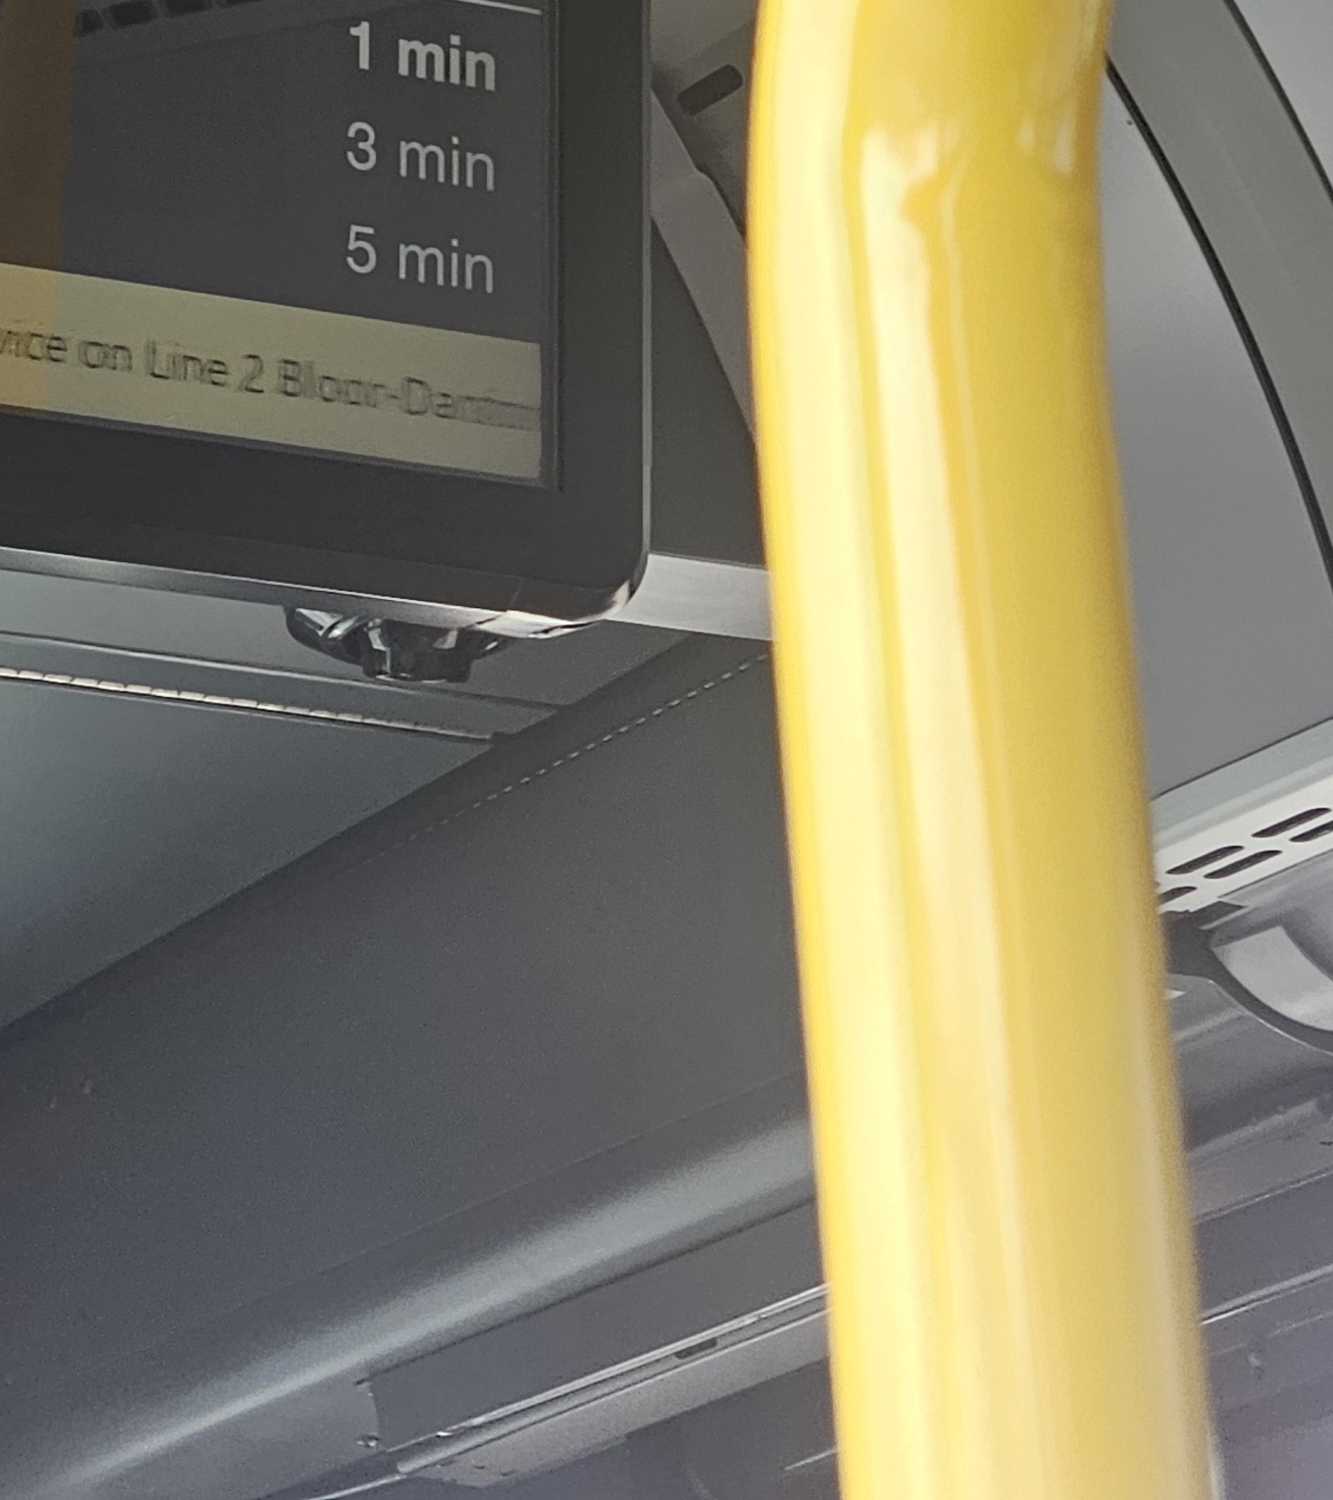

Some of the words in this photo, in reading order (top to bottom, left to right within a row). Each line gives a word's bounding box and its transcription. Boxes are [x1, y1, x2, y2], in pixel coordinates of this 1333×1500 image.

[349, 21, 370, 70] 1
[398, 32, 495, 95] min
[347, 121, 377, 171] 3
[399, 134, 494, 190] min
[346, 224, 377, 274] 5
[399, 237, 494, 294] min
[78, 339, 133, 371] on
[144, 337, 229, 387] Line
[237, 353, 265, 393] 2
